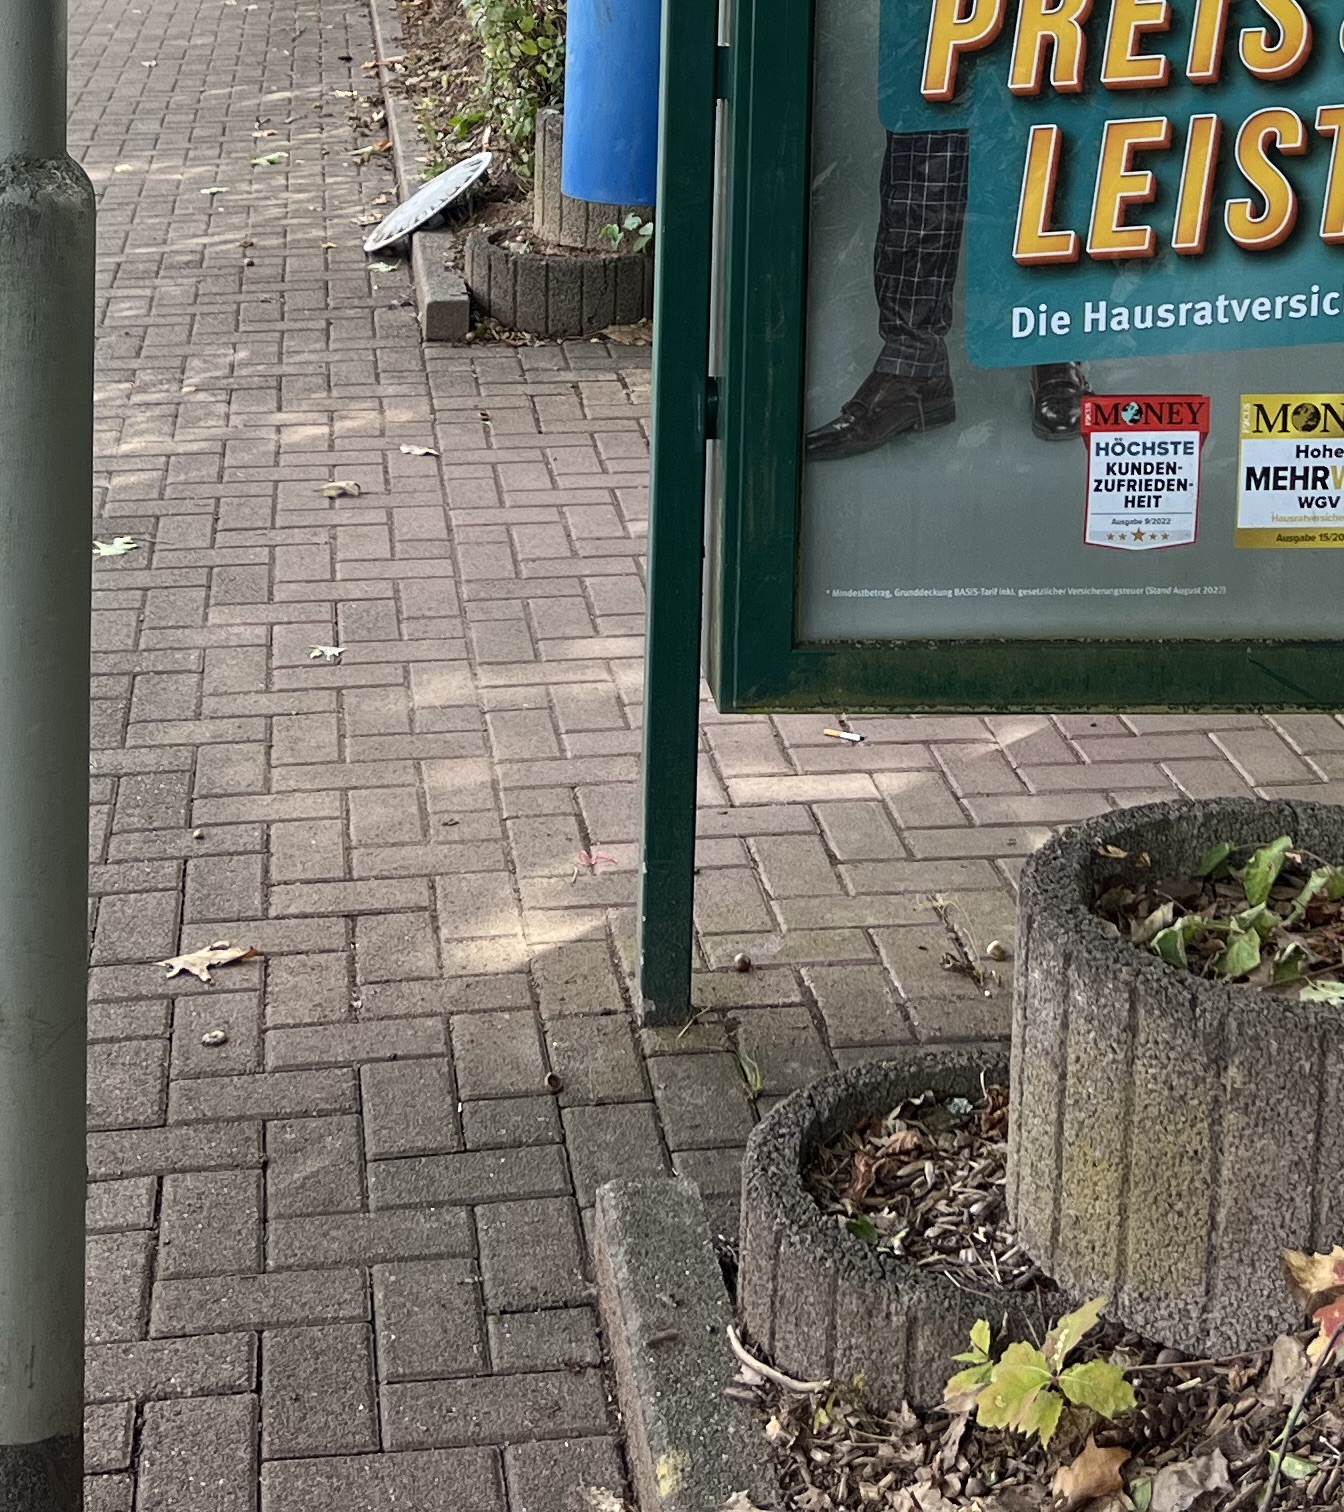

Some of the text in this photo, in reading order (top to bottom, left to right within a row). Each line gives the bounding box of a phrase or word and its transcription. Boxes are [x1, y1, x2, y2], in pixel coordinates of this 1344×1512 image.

[1011, 305, 1073, 340] Die
[1092, 401, 1206, 426] MONEY
[1095, 437, 1194, 457] HÖCHSTE
[1106, 462, 1183, 476] KUNDEN-
[1093, 478, 1194, 493] ZUFRIEDEN-
[1124, 495, 1162, 508] HEIT
[1297, 496, 1341, 509] WGV
[1111, 518, 1142, 527] Ausgabe
[1276, 533, 1317, 544] Ausgabe
[894, 587, 953, 598] Grunddeckung
[1173, 586, 1201, 596] August
